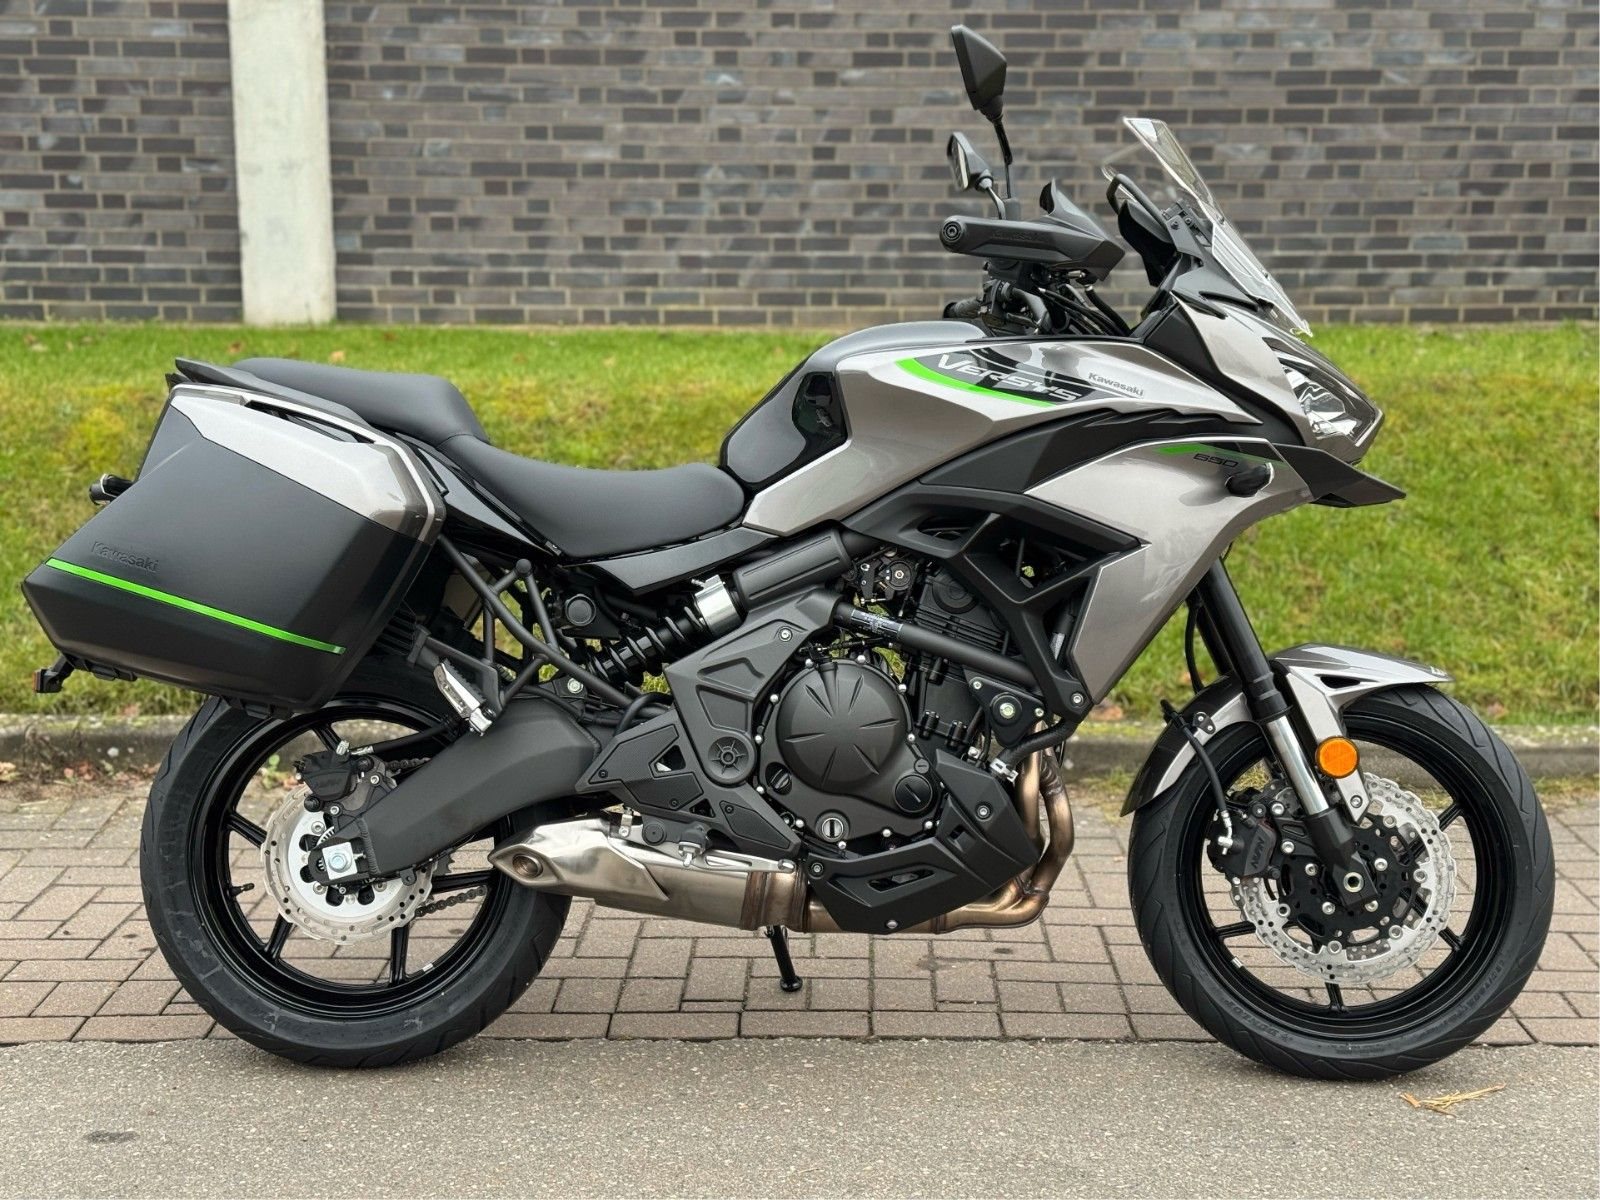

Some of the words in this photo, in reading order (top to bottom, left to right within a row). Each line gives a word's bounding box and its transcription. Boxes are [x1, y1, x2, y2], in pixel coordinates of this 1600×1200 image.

[1088, 372, 1144, 397] Kawasaki
[1193, 453, 1239, 468] 650
[91, 541, 159, 572] Kawasaki
